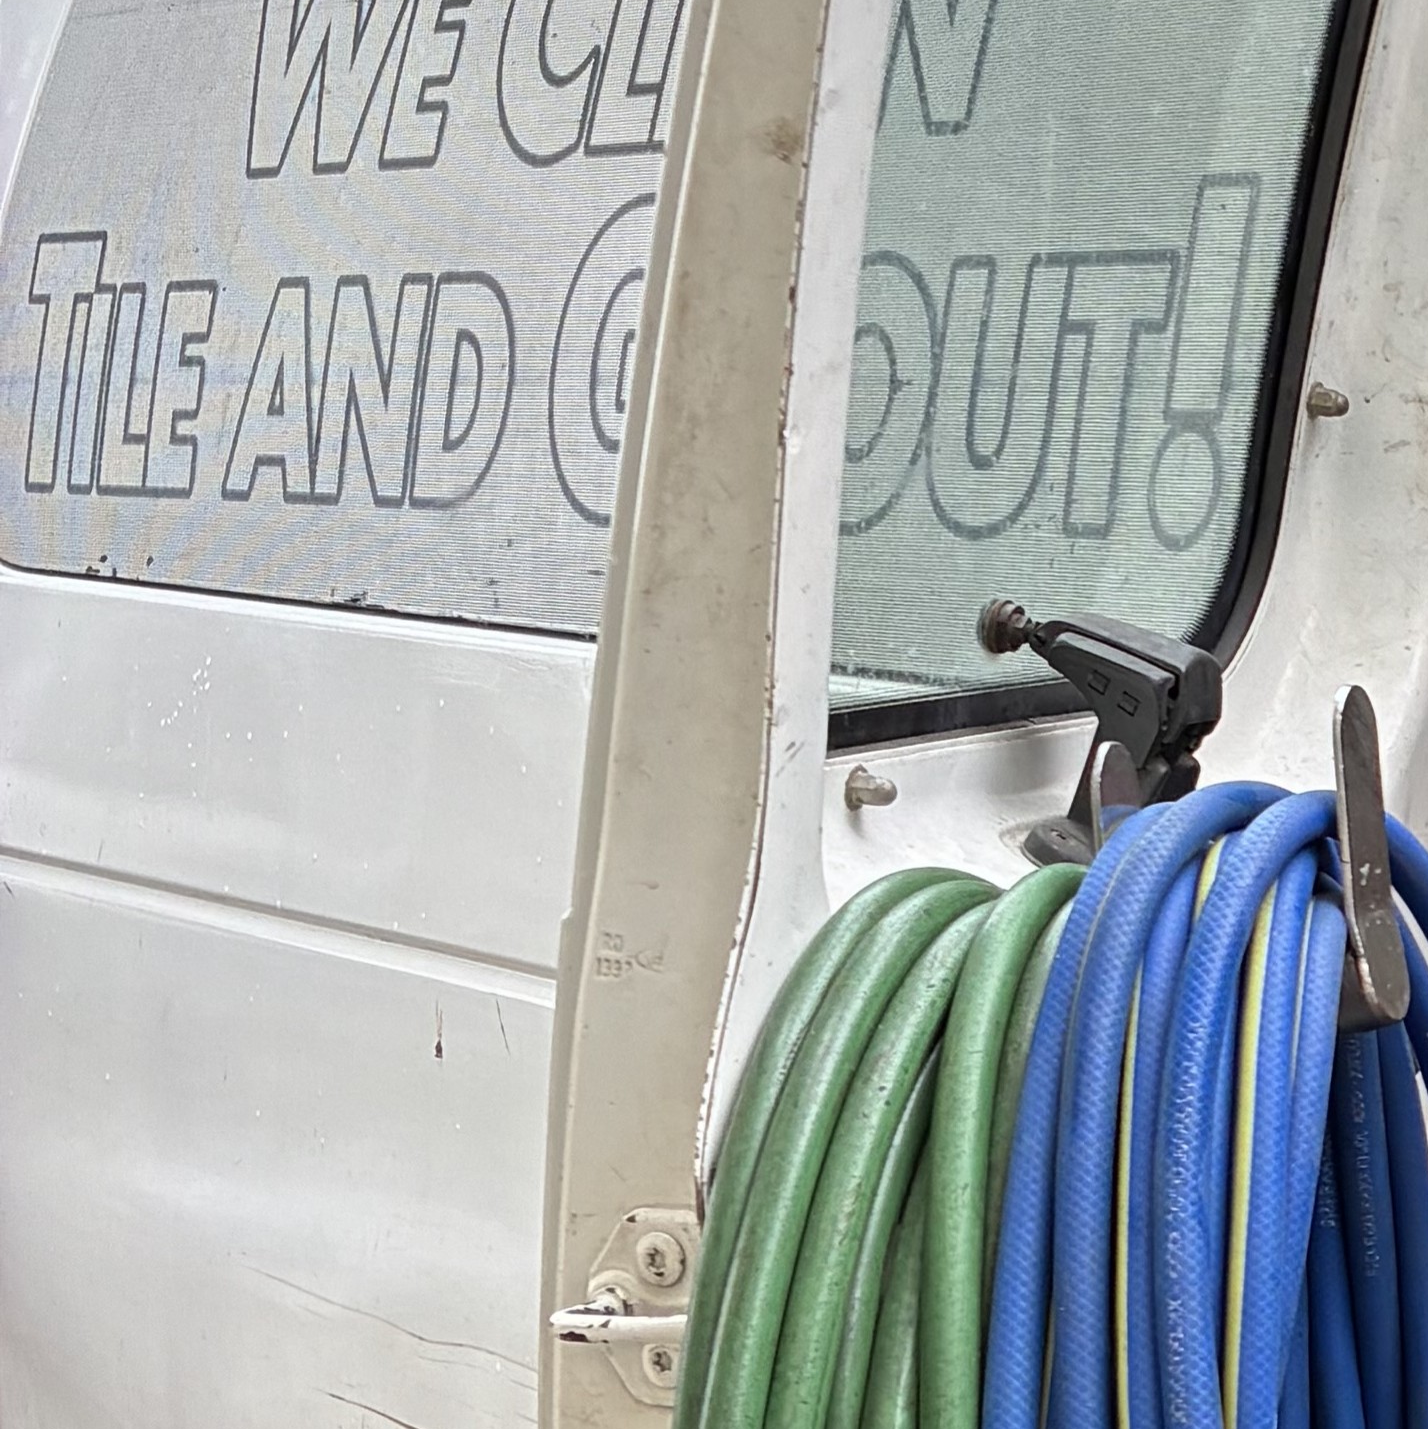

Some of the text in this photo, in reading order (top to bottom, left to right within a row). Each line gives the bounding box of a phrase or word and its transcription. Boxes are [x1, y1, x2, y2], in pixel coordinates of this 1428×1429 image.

[24, 173, 1262, 552] TILE AND GOUT!
